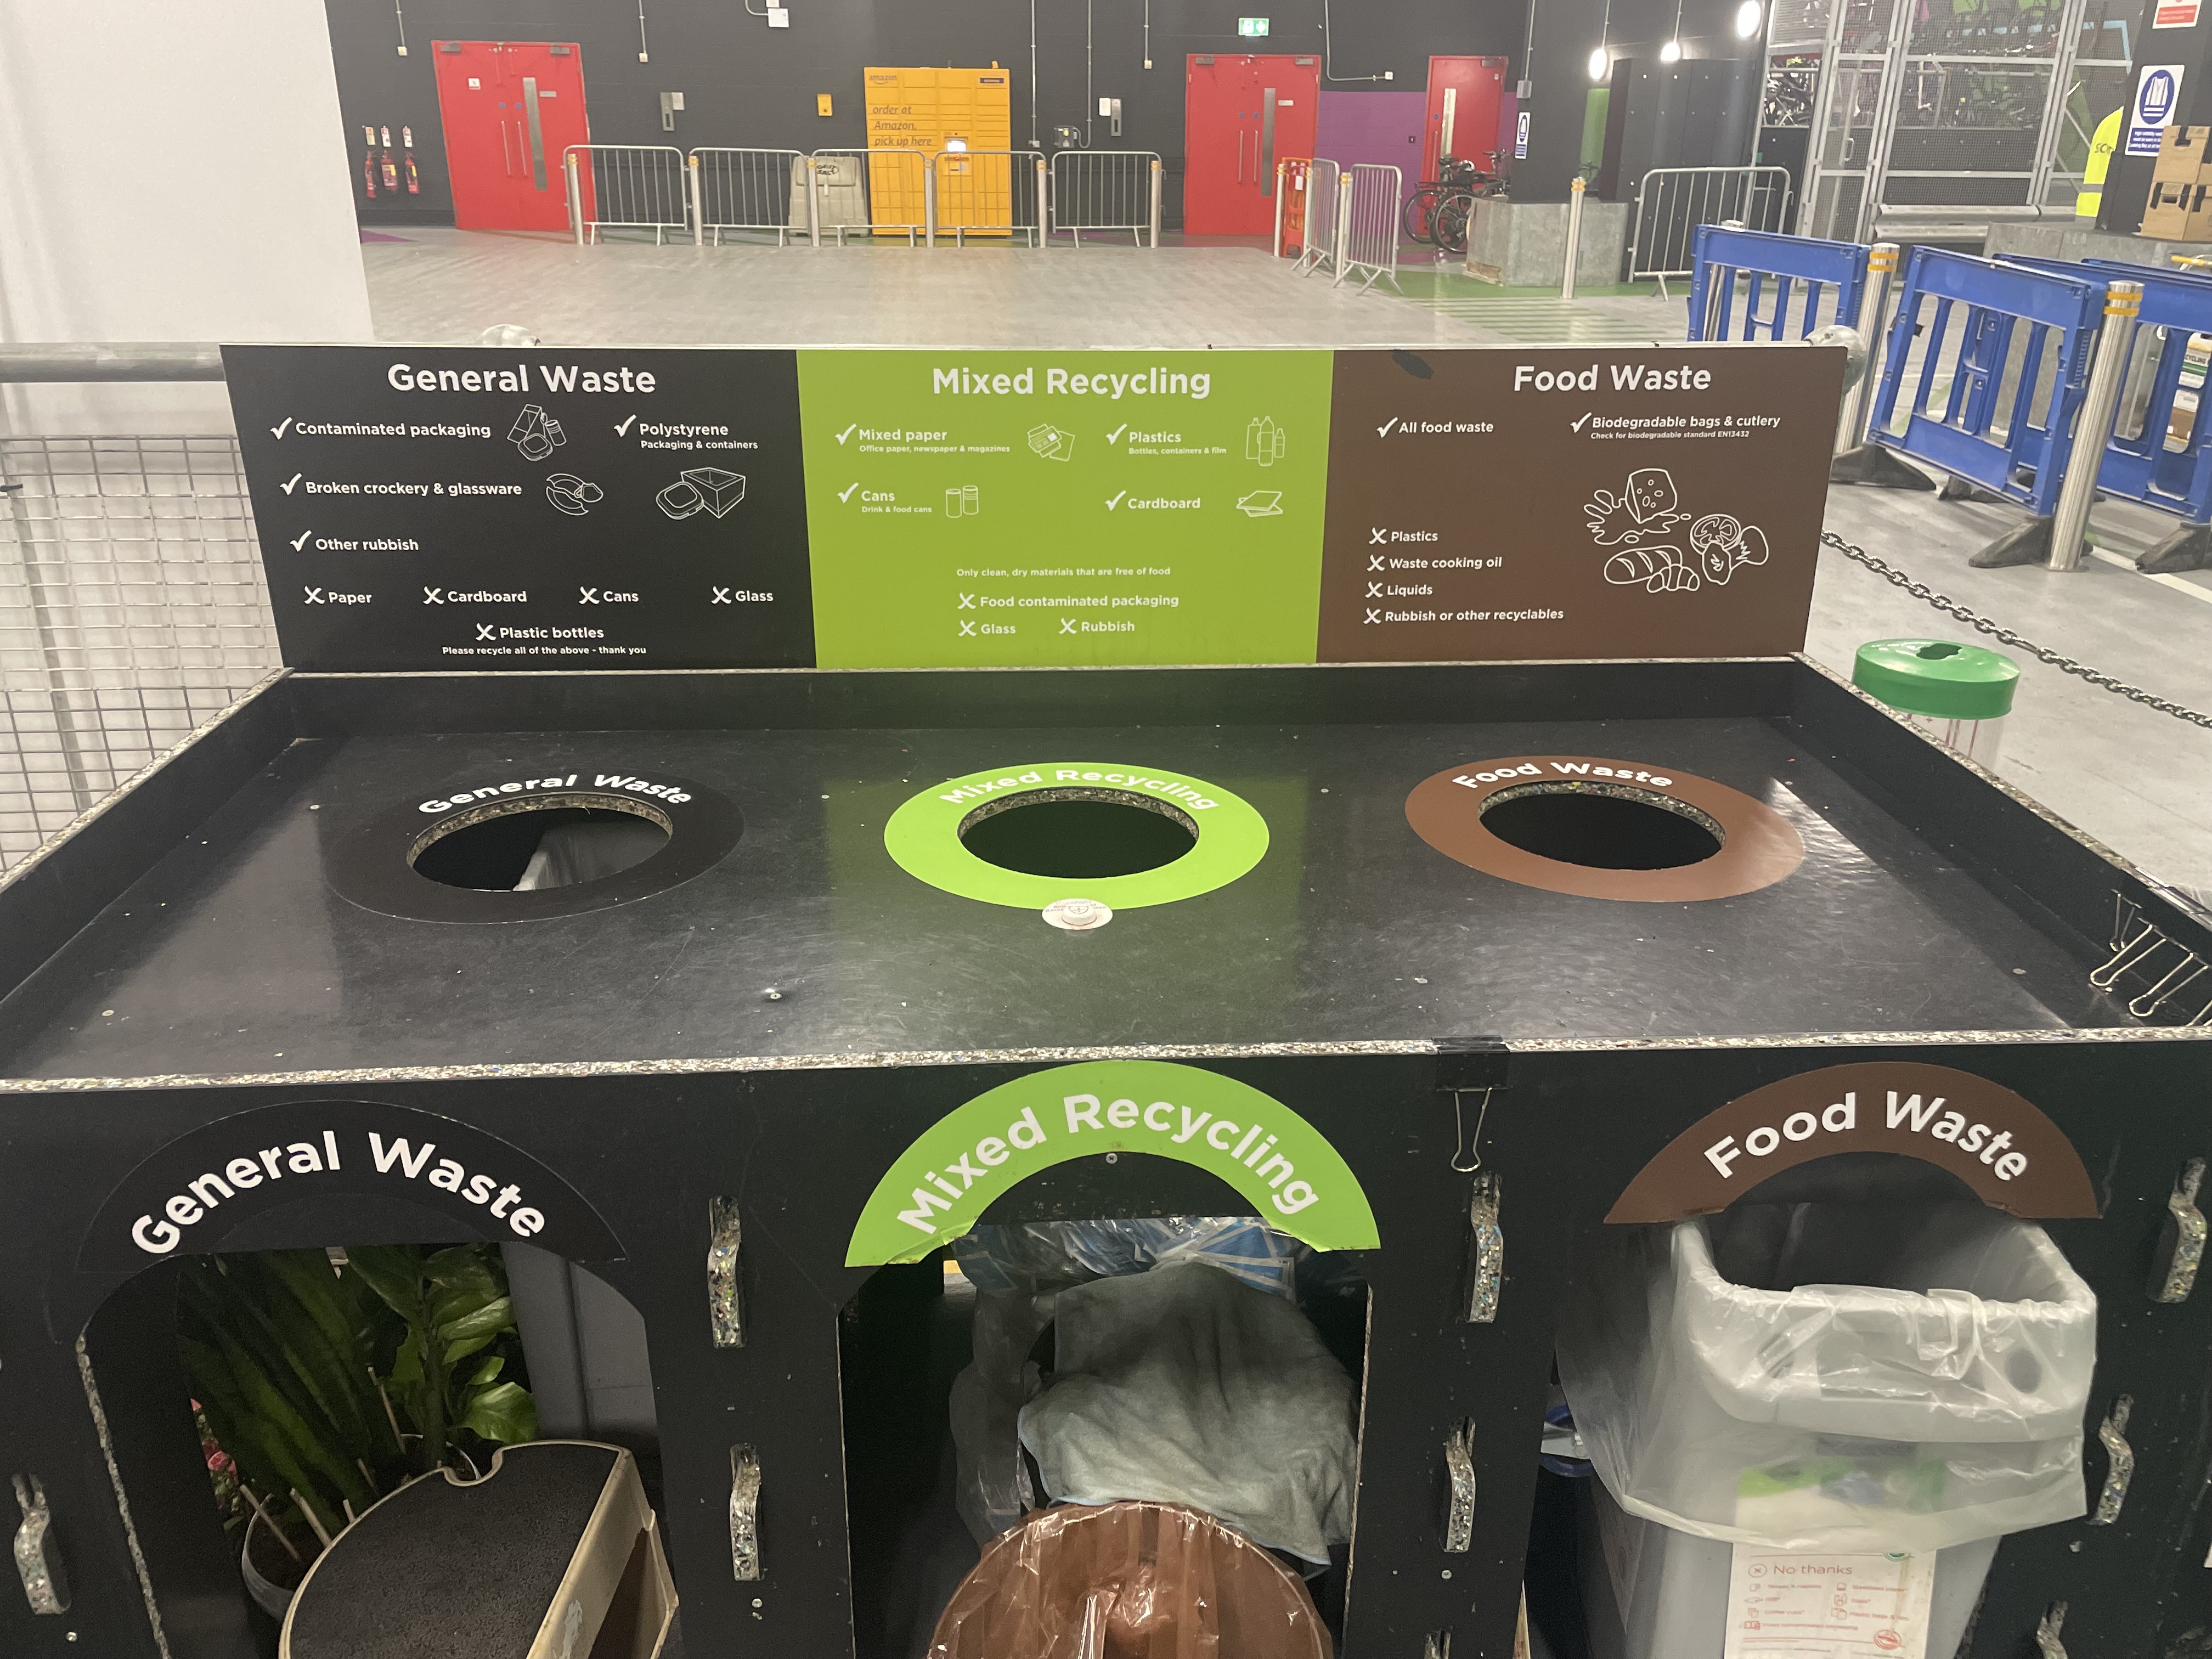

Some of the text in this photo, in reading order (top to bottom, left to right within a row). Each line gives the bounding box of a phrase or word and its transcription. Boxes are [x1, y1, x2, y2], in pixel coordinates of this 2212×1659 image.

[873, 104, 899, 114] order
[874, 136, 932, 147] pick up here
[388, 364, 656, 393] General Waste
[933, 367, 1210, 399] Mixed Recycling
[1514, 364, 1711, 391] Food Waste
[1398, 421, 1494, 433] All food waste
[1592, 415, 1781, 430] Biodegradable bags & cutlery
[295, 422, 491, 438] Contaminated packaging
[639, 422, 729, 438] Polystyrene
[859, 428, 947, 443] Mixed paper
[1628, 431, 1682, 440] biodegradable
[1129, 431, 1181, 443] Plastics
[641, 440, 758, 450] Packaging & containers
[967, 445, 1010, 454] magazines
[306, 481, 522, 496] Broken crockery & glassware
[861, 490, 895, 502] Cans
[1127, 497, 1201, 509] Cardboard
[1391, 531, 1438, 542] Plastics
[315, 538, 419, 551] Other rubbish
[1389, 556, 1502, 569] Waste cooking oil
[956, 568, 979, 578] Only
[981, 568, 1009, 578] clean,
[1012, 568, 1028, 578] dry
[1030, 568, 1074, 576] materials
[1115, 567, 1134, 575] free
[1136, 567, 1147, 575] of
[1148, 567, 1171, 575] food
[447, 590, 527, 602] Cardboard
[603, 590, 639, 602] Cans
[735, 590, 774, 602] Glass
[1387, 584, 1433, 597] Liquids
[328, 591, 372, 605] Paper
[980, 595, 1179, 608] Food contaminated packaging
[1385, 608, 1564, 622] Rubbish or other recyclables
[499, 627, 605, 639] Plastic bottles
[980, 623, 1016, 634] Glass
[1081, 621, 1135, 632] Rubbish
[442, 646, 473, 654] Please
[476, 646, 511, 656] recycle
[515, 646, 526, 654] all
[528, 646, 539, 654] of
[541, 646, 557, 654] the
[560, 646, 590, 654] above
[598, 646, 627, 654] thank
[628, 647, 646, 656] you
[1452, 762, 1673, 788] Food Waste
[419, 774, 691, 813] General Waste
[940, 770, 1219, 810] Mixed Recycling
[1703, 1091, 2028, 1181] Food Waste
[896, 1093, 1319, 1235] Mixed Recycling
[132, 1130, 545, 1254] General Waste
[1774, 1565, 1853, 1575] No thanks
